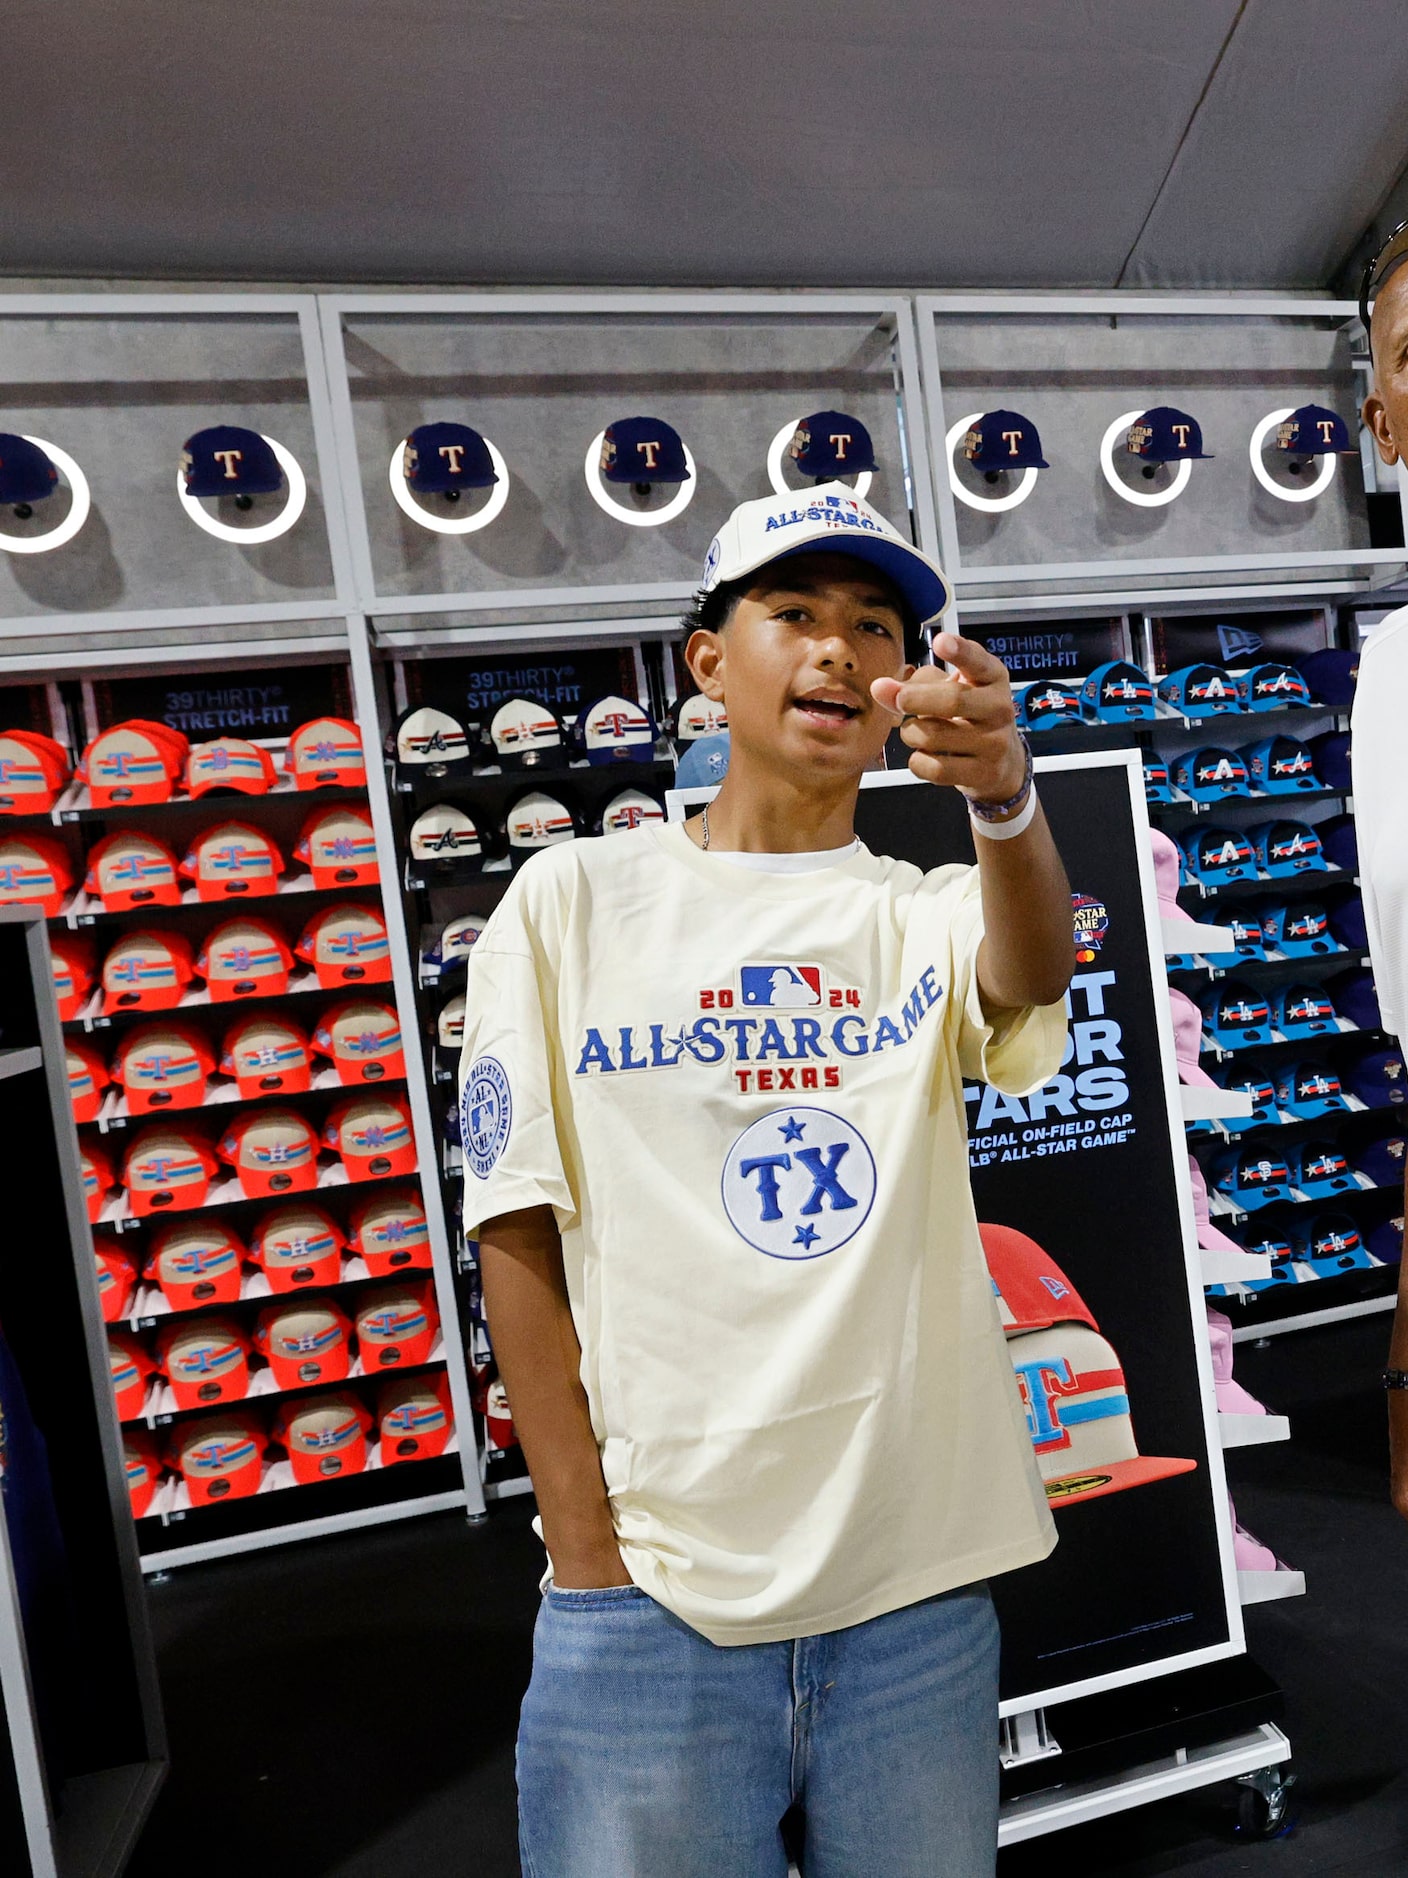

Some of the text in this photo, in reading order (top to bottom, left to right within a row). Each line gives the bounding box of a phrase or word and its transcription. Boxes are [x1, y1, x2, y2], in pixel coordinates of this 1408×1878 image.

[1172, 424, 1190, 448] T
[1316, 420, 1335, 443] T
[637, 441, 661, 468] T
[829, 434, 851, 459] T
[1002, 431, 1022, 457] T
[214, 450, 242, 479] T
[438, 445, 465, 473] T
[998, 651, 1079, 670] TRETCH-FIT
[1121, 677, 1137, 698] LA
[1205, 676, 1225, 698] A
[1270, 672, 1291, 693] A
[163, 705, 290, 731] STRETCH-FIT
[604, 713, 628, 738] T
[107, 752, 134, 778] T
[1212, 758, 1234, 780] A
[1287, 750, 1307, 773] A
[620, 807, 643, 829] T
[1219, 840, 1240, 862] A
[1287, 833, 1307, 855] A
[118, 855, 146, 880] T
[219, 845, 246, 871] T
[1074, 918, 1099, 931] AME
[1303, 915, 1320, 935] LA
[338, 931, 364, 957] T
[118, 957, 145, 983] T
[700, 989, 861, 1009] 20 24
[1065, 970, 1116, 1019] IT
[830, 964, 944, 1057] GAME
[1238, 1001, 1254, 1021] LA
[1303, 997, 1319, 1018] LA
[145, 1056, 171, 1081] T
[735, 1066, 840, 1093] TEXAS
[1314, 1075, 1329, 1094] LA
[968, 1113, 1132, 1150] FICIAL ON-FIELD CAP
[970, 1150, 998, 1168] LB®
[1001, 1136, 1077, 1163] ALL-STAR
[148, 1158, 174, 1183] T
[1319, 1155, 1337, 1175] LA
[739, 1142, 858, 1222] TX
[1262, 1240, 1279, 1260] LA
[1329, 1232, 1345, 1251] LA
[182, 1250, 209, 1275] T
[374, 1313, 400, 1336] T
[189, 1348, 216, 1372] T
[395, 1406, 419, 1430] T
[202, 1444, 228, 1469] T
